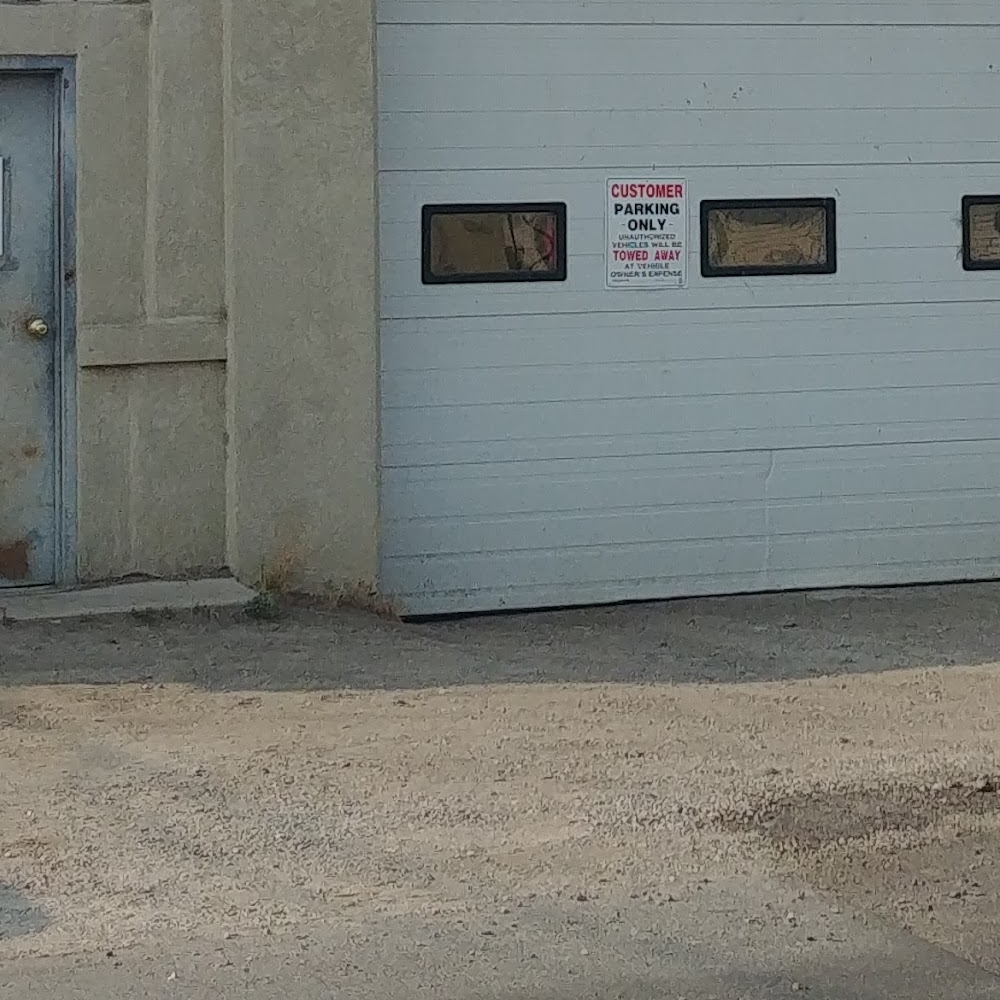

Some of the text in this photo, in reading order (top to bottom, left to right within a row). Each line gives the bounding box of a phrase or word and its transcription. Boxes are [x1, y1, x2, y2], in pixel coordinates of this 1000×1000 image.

[611, 183, 683, 198] CUSTOMER
[614, 203, 680, 215] PARKING
[613, 250, 681, 261] TOWED AWAY
